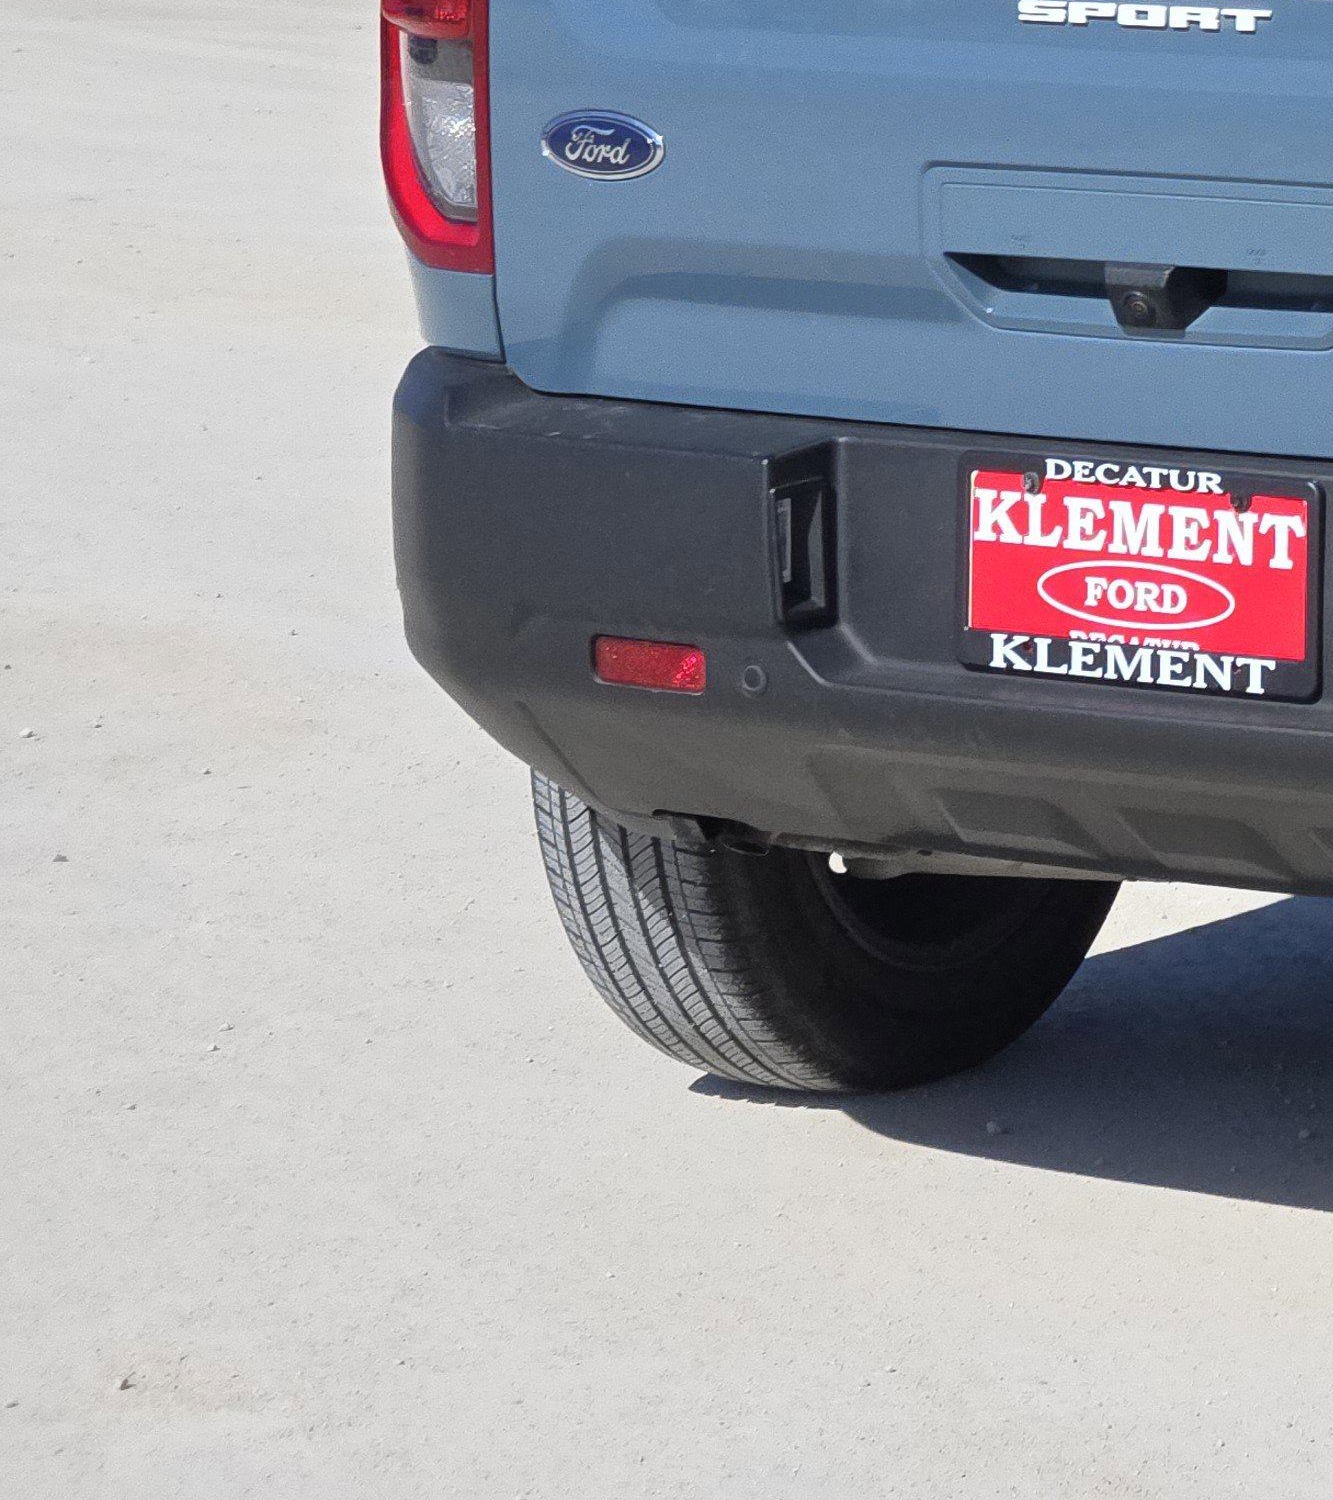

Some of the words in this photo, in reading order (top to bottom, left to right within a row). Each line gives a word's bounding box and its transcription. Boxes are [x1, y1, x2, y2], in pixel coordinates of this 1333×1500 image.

[564, 124, 632, 165] Ford
[1044, 457, 1225, 494] DECATUR
[973, 487, 1306, 570] KLEMENT
[1084, 575, 1188, 615] FORD
[989, 632, 1277, 695] KLEMENT
